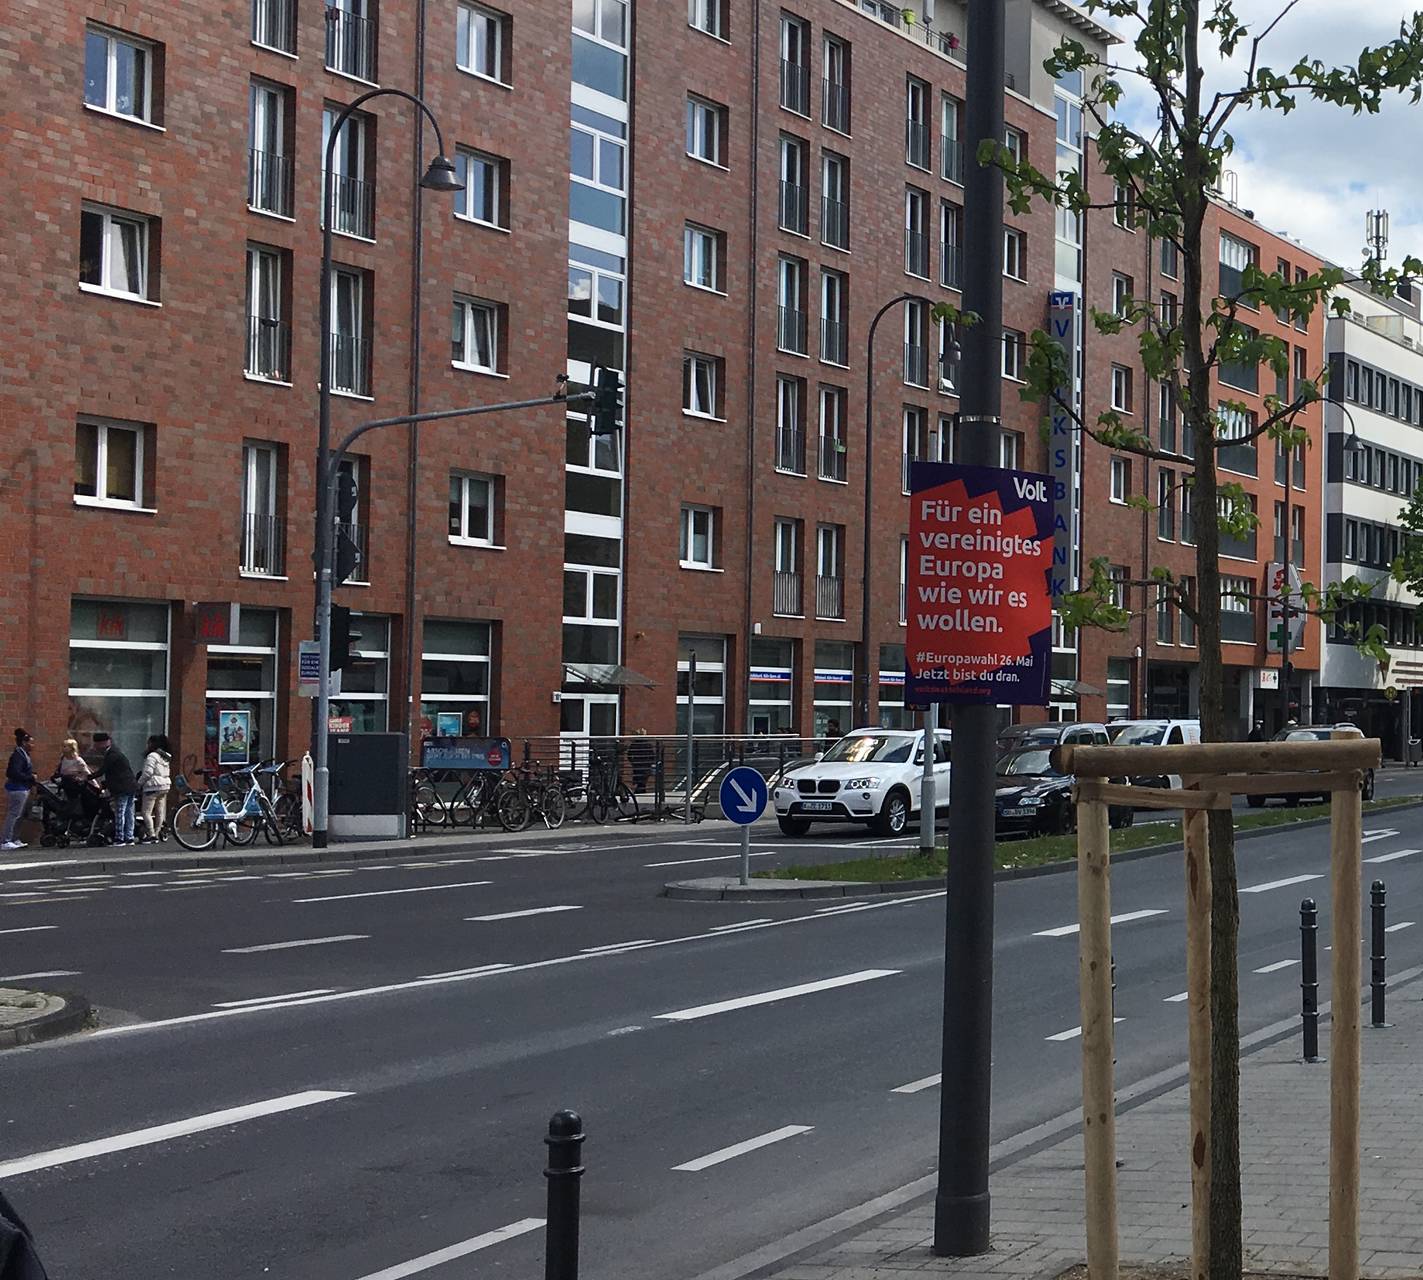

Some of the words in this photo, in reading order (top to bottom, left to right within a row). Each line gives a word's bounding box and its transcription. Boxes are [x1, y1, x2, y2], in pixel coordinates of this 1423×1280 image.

[1052, 319, 1070, 596] VLKSBANK
[1013, 476, 1048, 503] Volt
[920, 500, 962, 522] Für
[968, 503, 1002, 526] ein
[919, 530, 1041, 558] vereinigtes
[919, 555, 1003, 582] Europa
[918, 583, 962, 604] wie
[968, 586, 1003, 606] wir
[1008, 591, 1027, 608] es
[917, 609, 1003, 633] wollen.
[915, 651, 998, 667] #Europawahl
[1000, 654, 1015, 667] 26.
[1016, 655, 1033, 667] Mai
[914, 667, 951, 681] Jetzt
[953, 667, 977, 682] bist
[980, 668, 994, 682] du
[996, 669, 1020, 683] dran.
